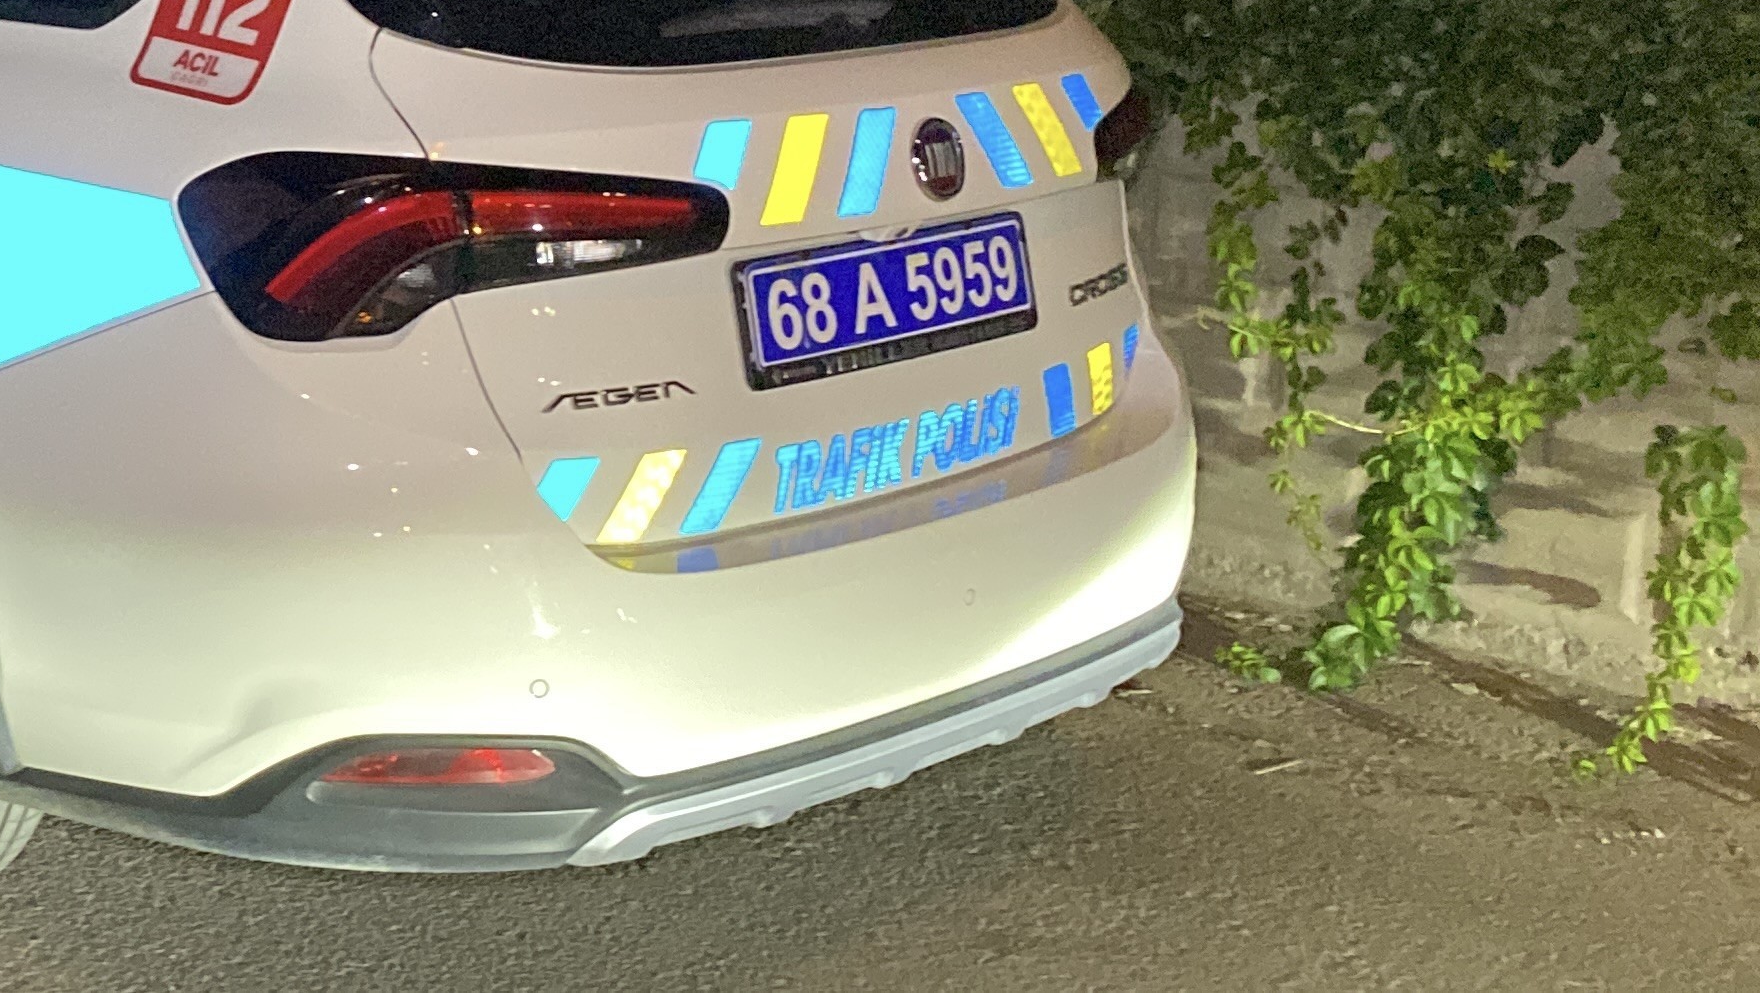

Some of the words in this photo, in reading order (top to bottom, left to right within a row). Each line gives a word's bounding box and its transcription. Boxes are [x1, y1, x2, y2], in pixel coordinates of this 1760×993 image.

[767, 272, 838, 350] 68
[855, 262, 898, 335] A
[905, 235, 1017, 321] 5959
